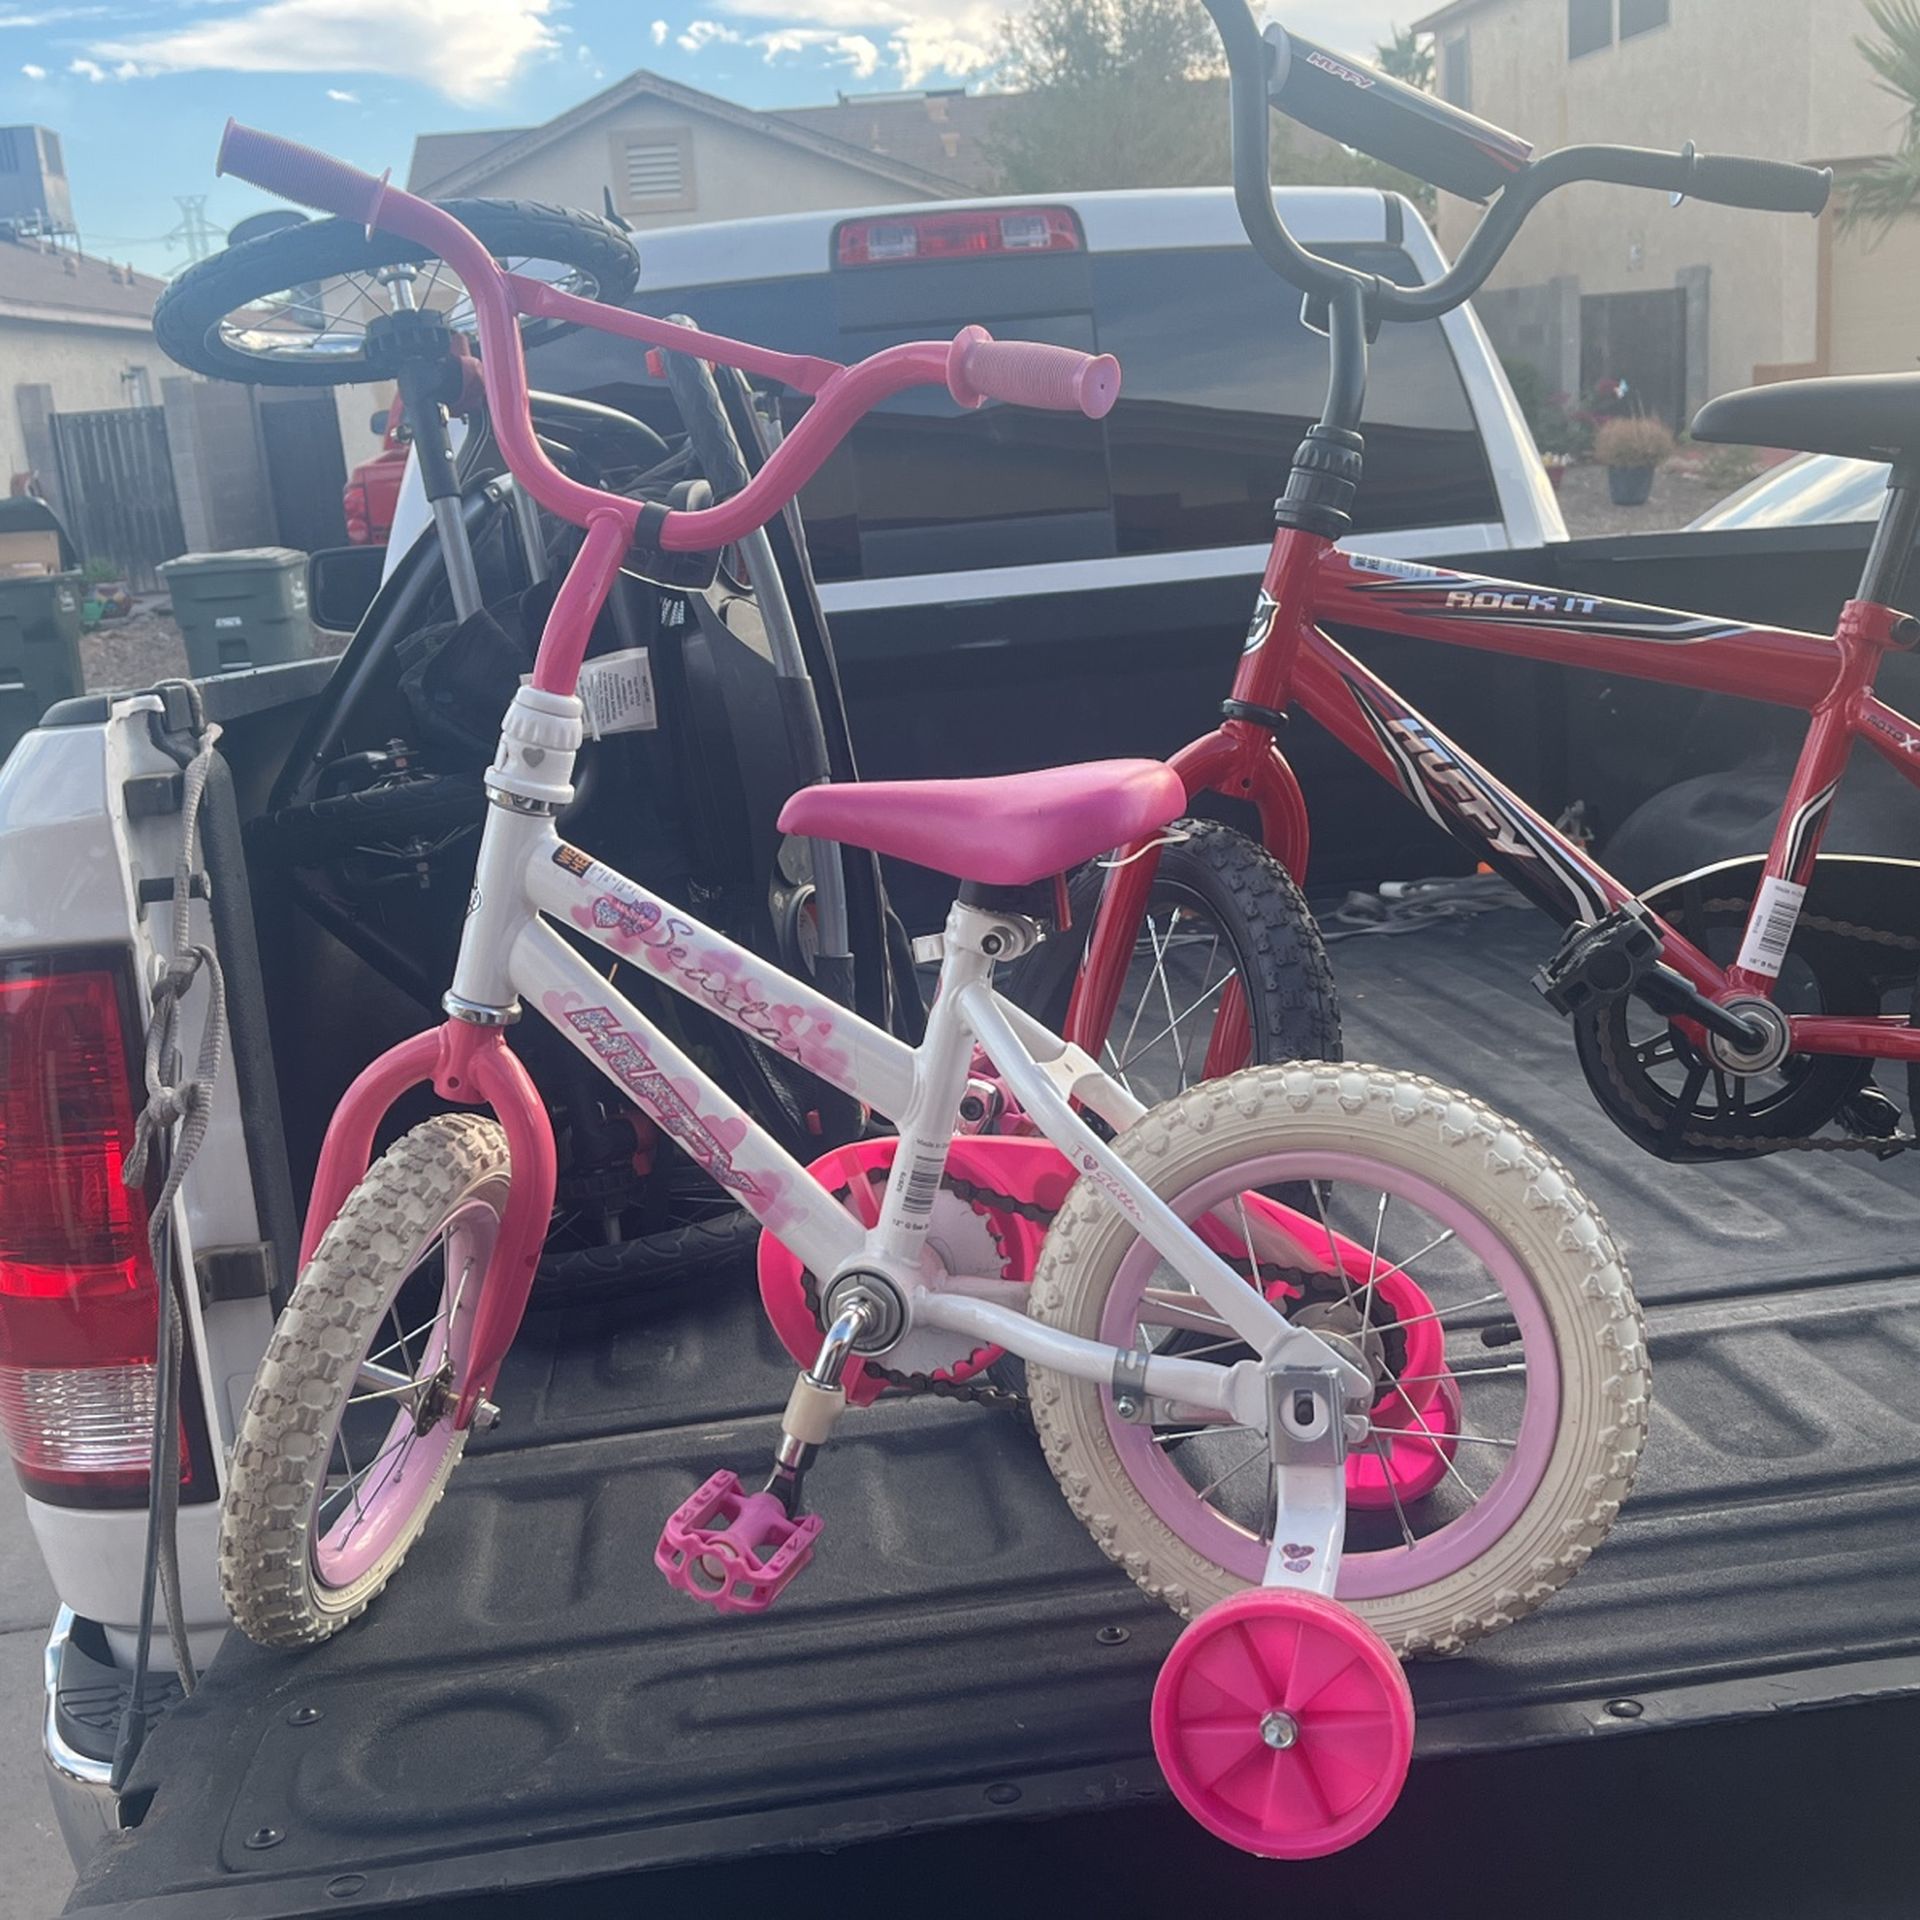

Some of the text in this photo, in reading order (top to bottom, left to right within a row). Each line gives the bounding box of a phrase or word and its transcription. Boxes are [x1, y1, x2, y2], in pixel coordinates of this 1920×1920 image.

[1306, 51, 1376, 89] HUFFY
[1445, 591, 1603, 614] ROCK IT
[1387, 718, 1537, 858] HUFFY
[564, 1006, 766, 1198] HUFFY
